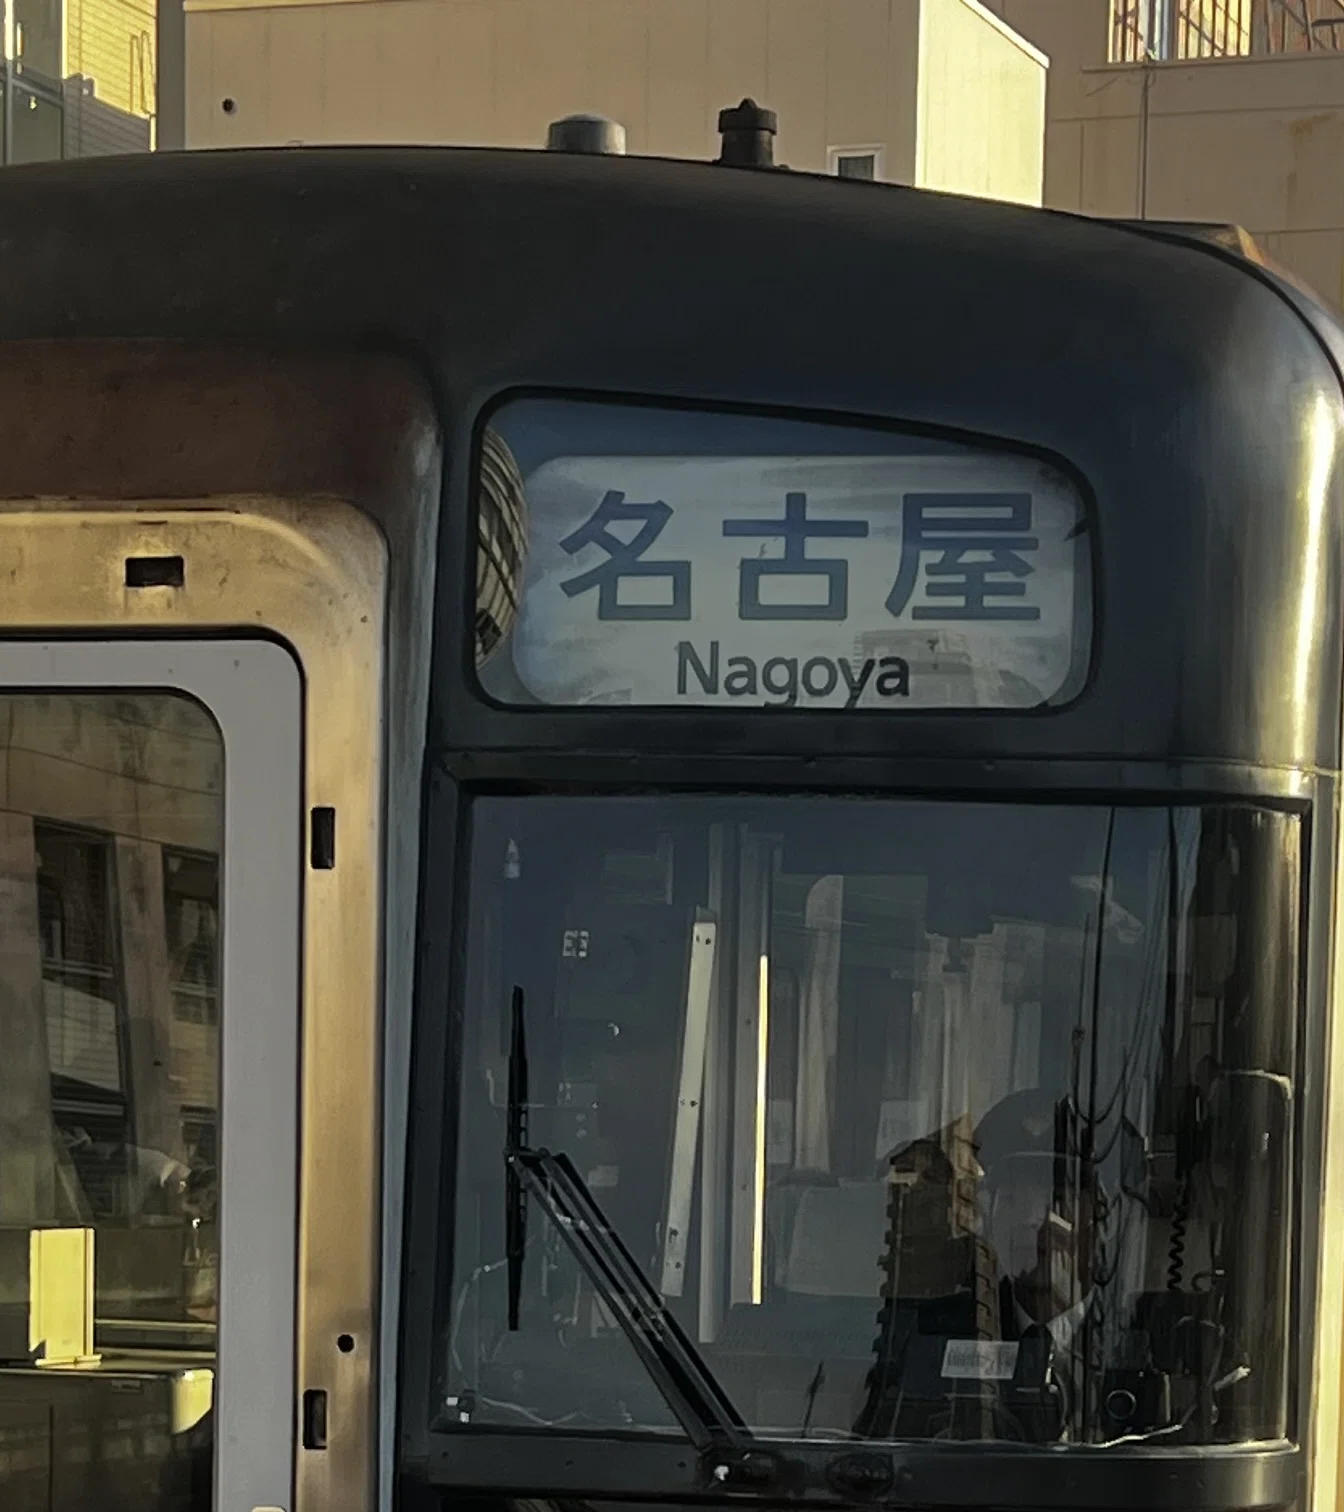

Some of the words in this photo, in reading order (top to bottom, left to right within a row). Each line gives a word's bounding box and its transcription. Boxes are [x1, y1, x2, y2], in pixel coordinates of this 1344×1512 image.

[558, 489, 1042, 621] 名古屋
[676, 640, 910, 708] Nagoya
